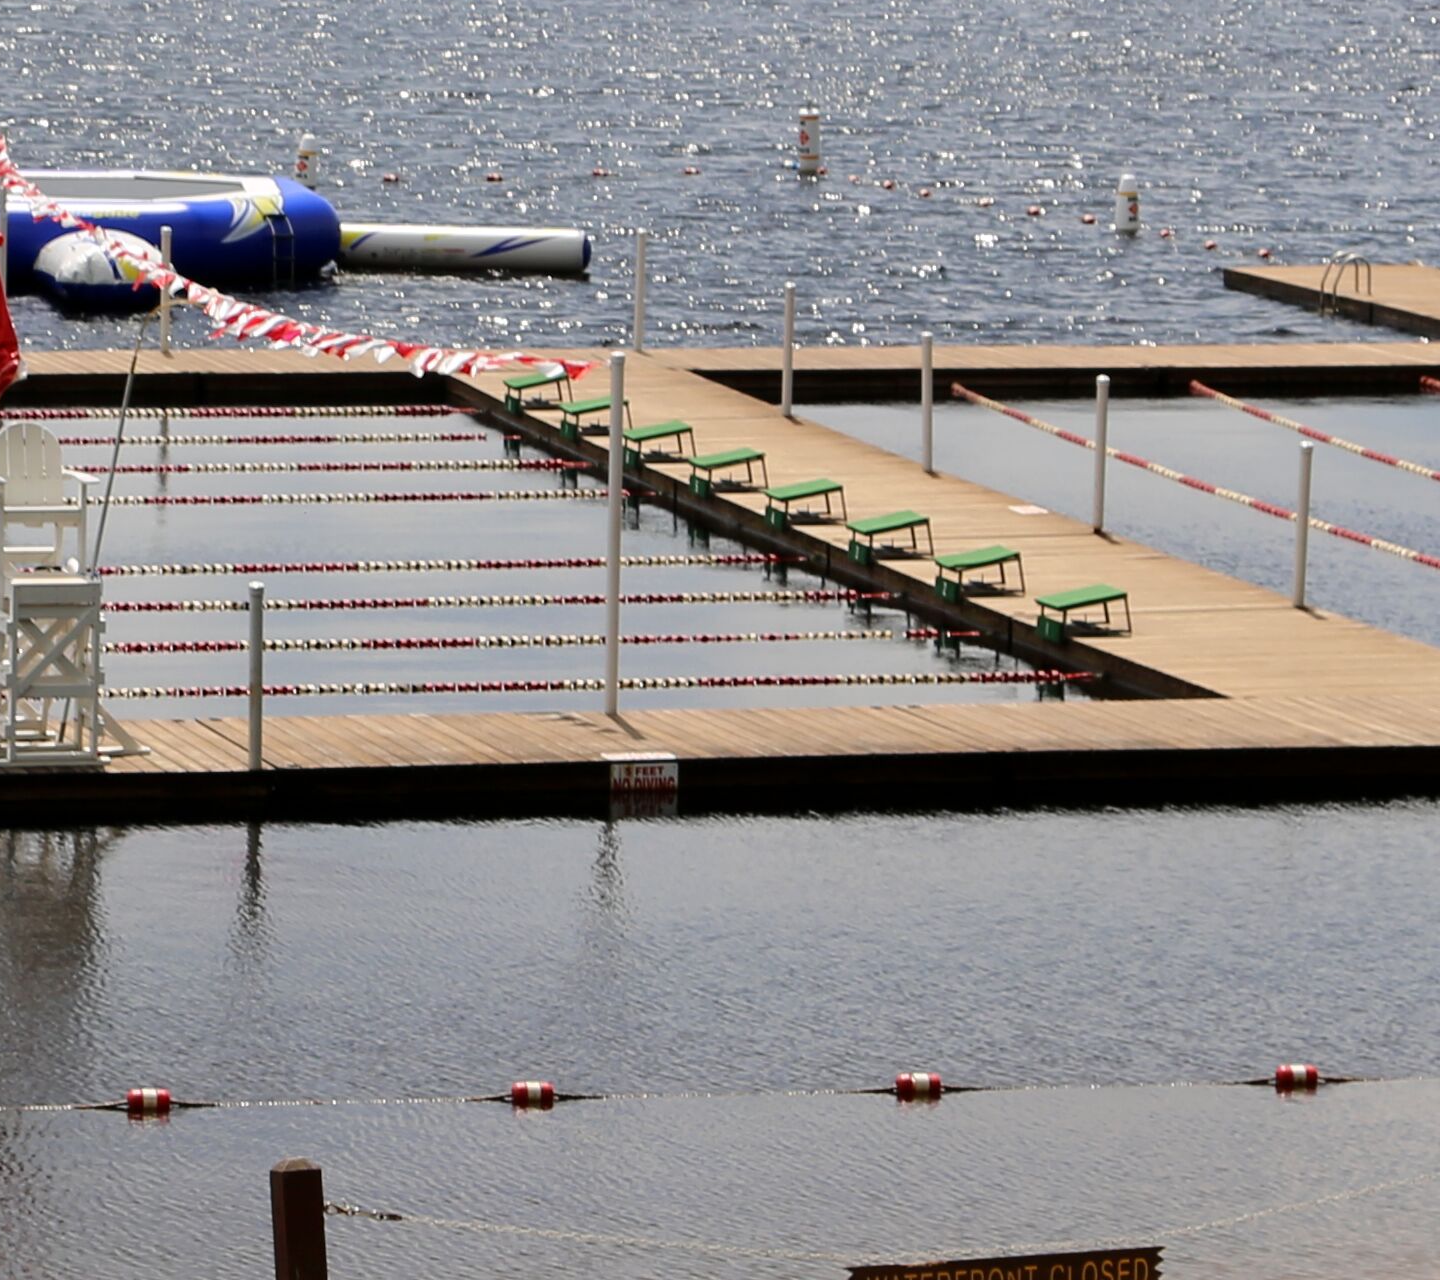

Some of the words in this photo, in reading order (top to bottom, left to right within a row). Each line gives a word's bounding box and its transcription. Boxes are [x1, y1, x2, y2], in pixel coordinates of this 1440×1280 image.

[635, 766, 664, 775] FEET
[613, 777, 631, 791] NO
[635, 776, 676, 792] DIVING
